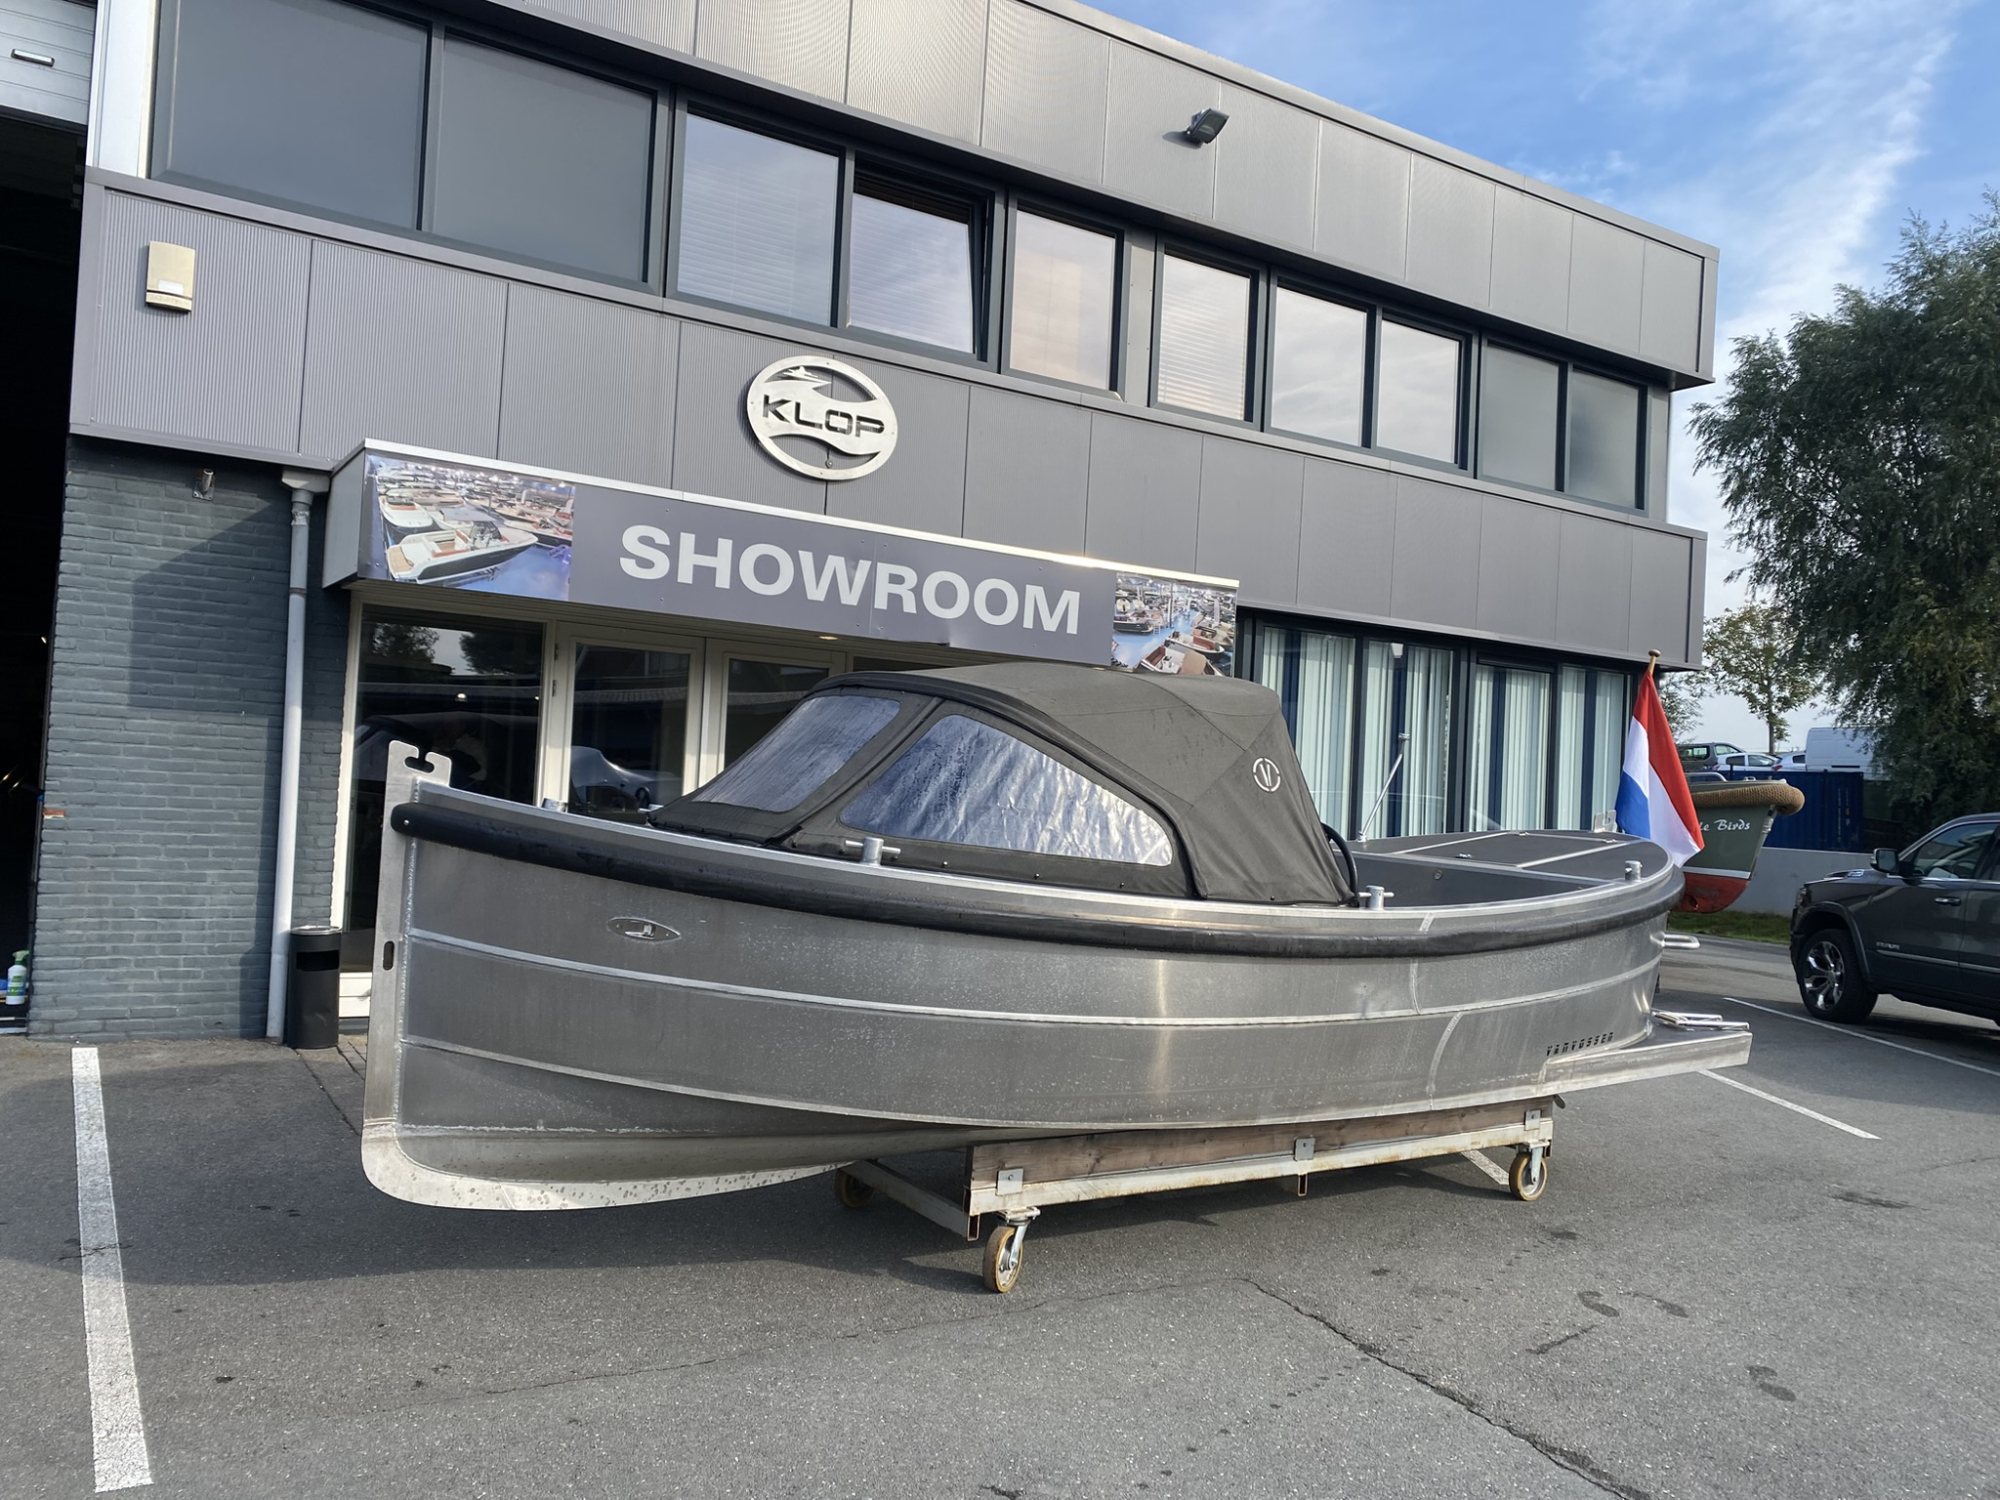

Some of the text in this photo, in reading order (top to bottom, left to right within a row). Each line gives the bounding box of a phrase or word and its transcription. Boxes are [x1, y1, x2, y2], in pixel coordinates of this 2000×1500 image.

[763, 394, 885, 438] KLOP
[619, 525, 1080, 635] SHOWROOM
[1713, 818, 1751, 831] Birds
